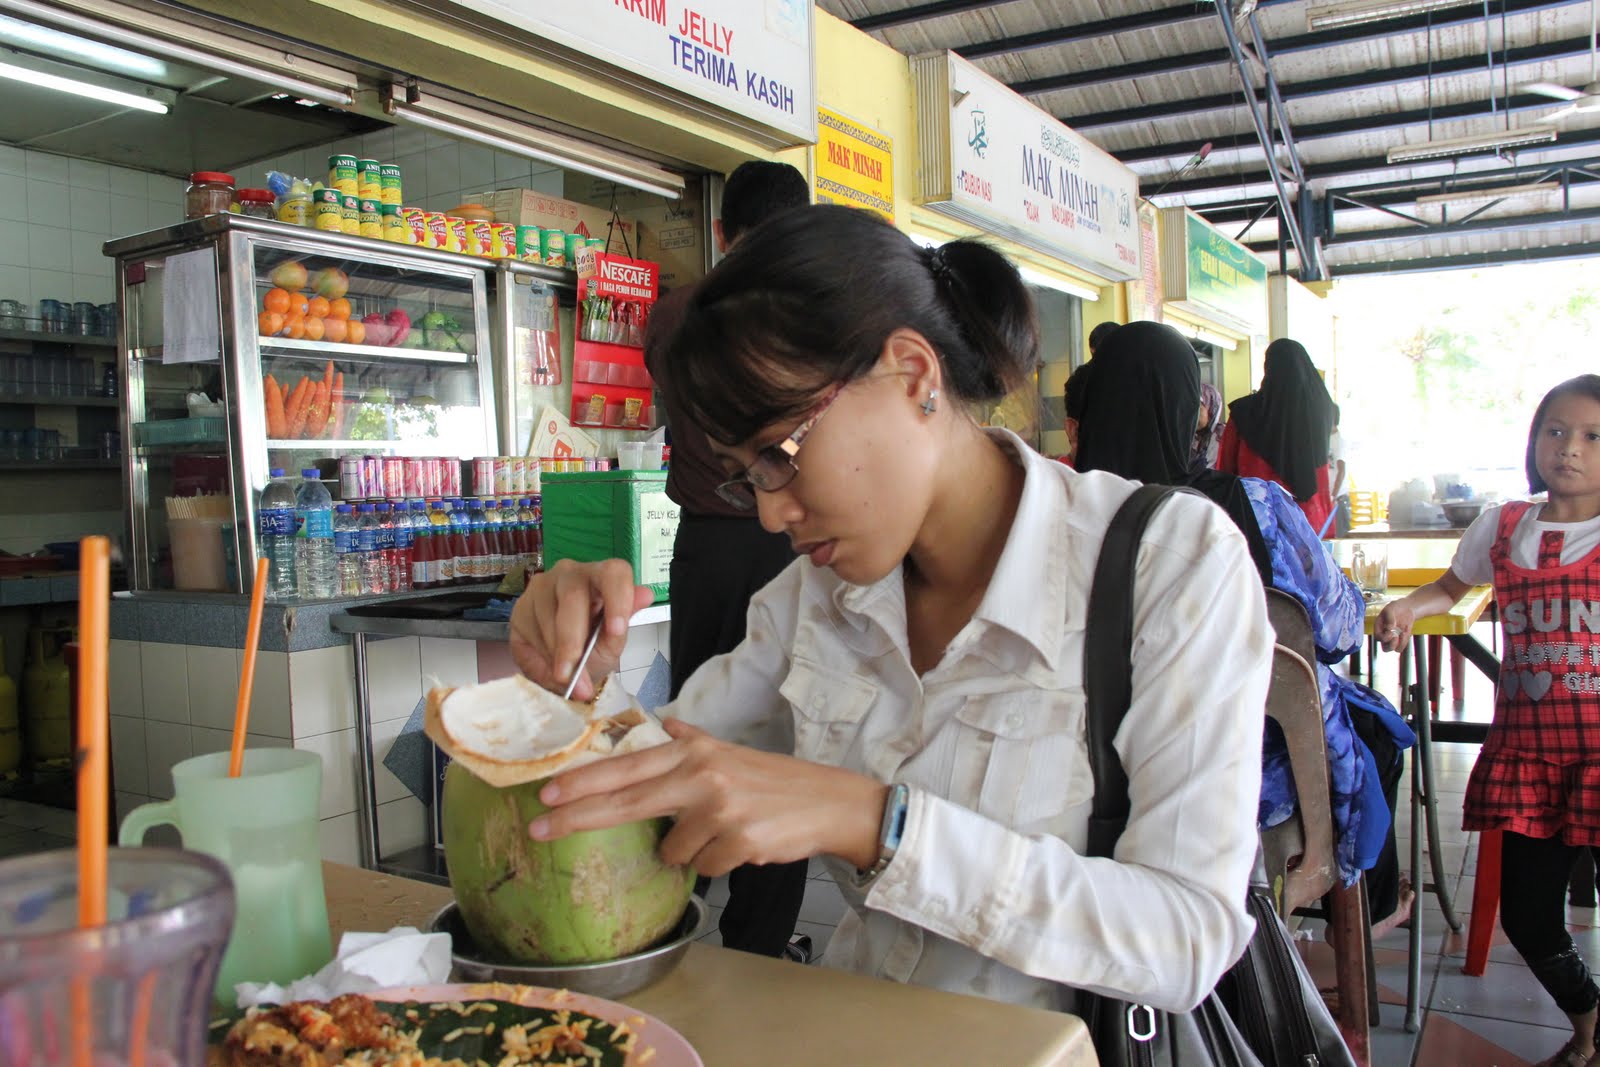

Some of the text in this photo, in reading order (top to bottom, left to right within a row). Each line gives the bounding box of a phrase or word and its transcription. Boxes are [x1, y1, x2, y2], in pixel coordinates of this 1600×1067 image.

[679, 8, 733, 55] JELLY
[669, 35, 794, 115] TERIMA KASIH
[336, 159, 357, 168] ANITA
[381, 169, 400, 177] ANITA
[828, 140, 883, 182] MAK MINAH
[1022, 145, 1053, 199] MAK
[1060, 166, 1099, 222] MINAH
[600, 259, 652, 287] NESCAFÉ
[647, 510, 665, 520] JELLY
[1514, 642, 1583, 665] LOVE
